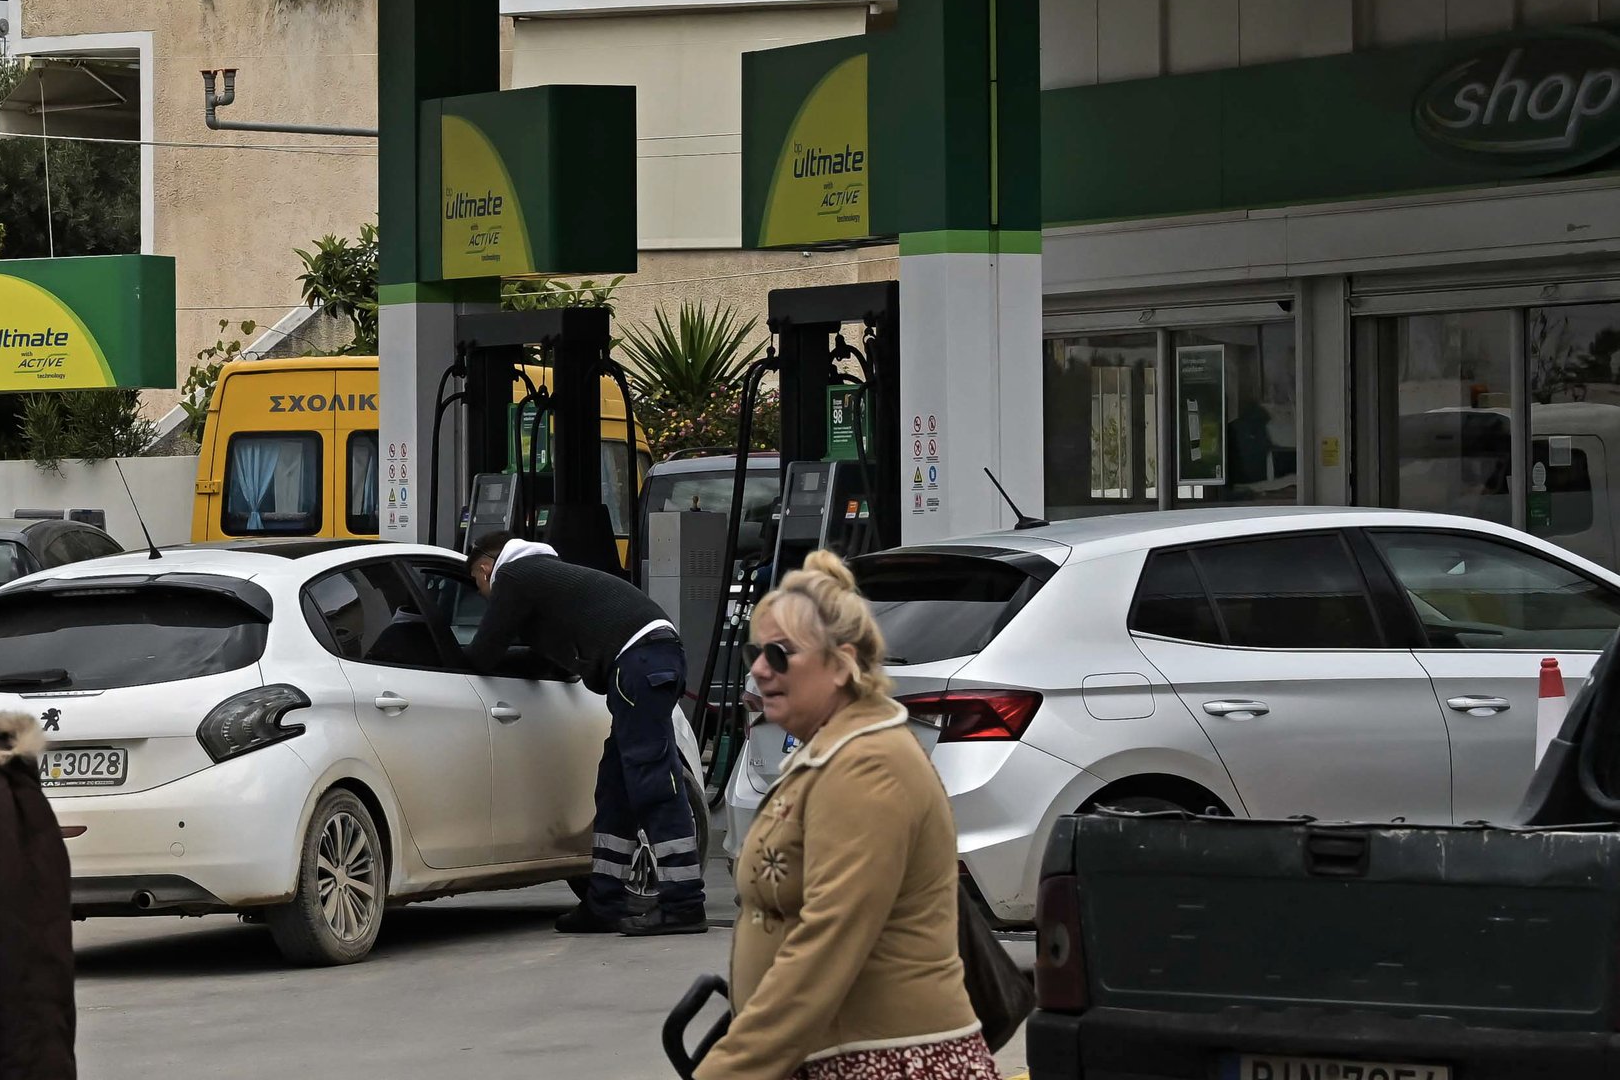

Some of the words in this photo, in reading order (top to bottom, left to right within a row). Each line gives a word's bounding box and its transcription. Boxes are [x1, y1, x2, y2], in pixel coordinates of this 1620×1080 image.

[1454, 48, 1620, 149] shop
[793, 143, 864, 178] ultimate
[445, 189, 502, 220] ultimate
[820, 190, 860, 208] ACTIVE
[468, 232, 500, 247] ACTIVE
[18, 357, 65, 368] ACTIVE
[833, 409, 843, 424] 98
